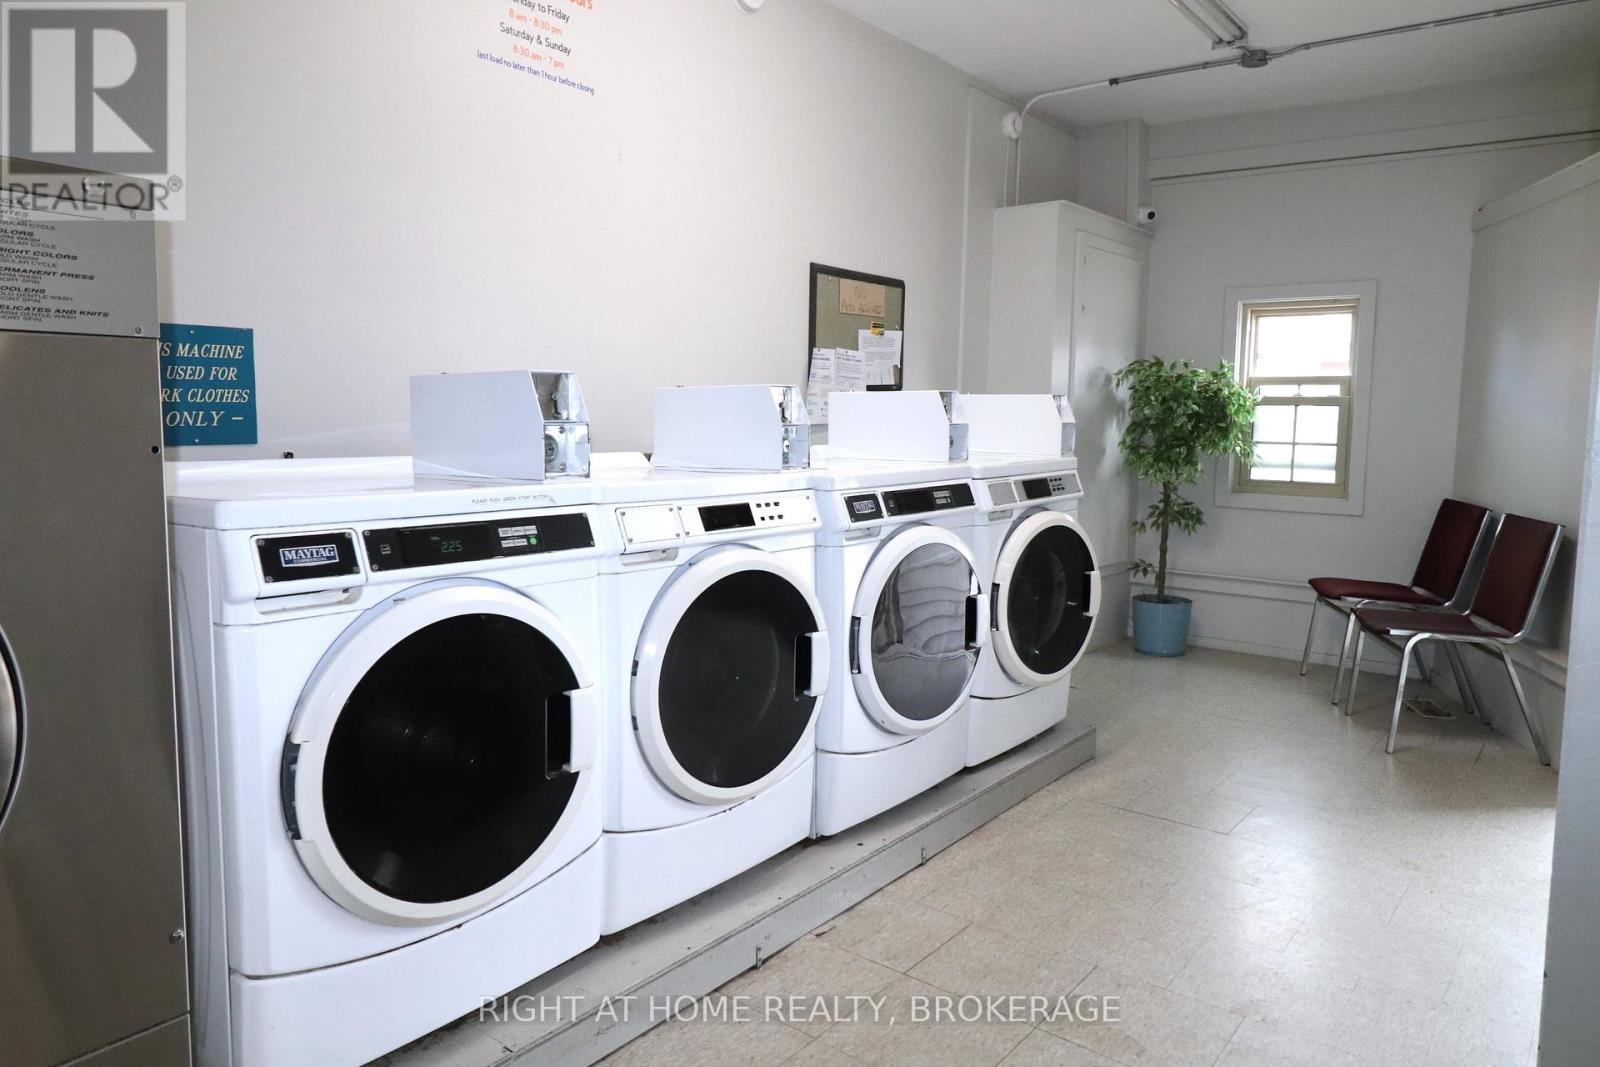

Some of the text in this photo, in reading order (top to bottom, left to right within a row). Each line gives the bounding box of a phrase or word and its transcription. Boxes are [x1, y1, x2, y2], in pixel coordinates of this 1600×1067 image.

[509, 8, 514, 18] 8
[517, 12, 528, 22] am
[533, 17, 550, 31] 8:30
[551, 25, 563, 35] pm
[538, 3, 547, 13] to
[547, 5, 570, 24] Friday
[500, 22, 571, 56] Saturday & Sunday
[512, 44, 529, 57] 8:30
[531, 52, 542, 61] am
[554, 60, 565, 69] pm
[477, 50, 489, 60] last
[490, 53, 503, 65] load
[503, 59, 512, 68] no
[512, 62, 526, 72] later
[527, 66, 540, 77] than
[544, 71, 558, 82] hour
[558, 75, 576, 88] before
[577, 82, 595, 96] closing
[33, 251, 78, 261] COLORS
[60, 272, 96, 281] PRESS
[79, 310, 110, 318] KNITS
[176, 343, 245, 359] MACHINE
[166, 365, 237, 381] USED FOR
[187, 388, 250, 403] CLOTHES
[166, 411, 225, 427] ONLY
[284, 547, 335, 561] MAYTAG
